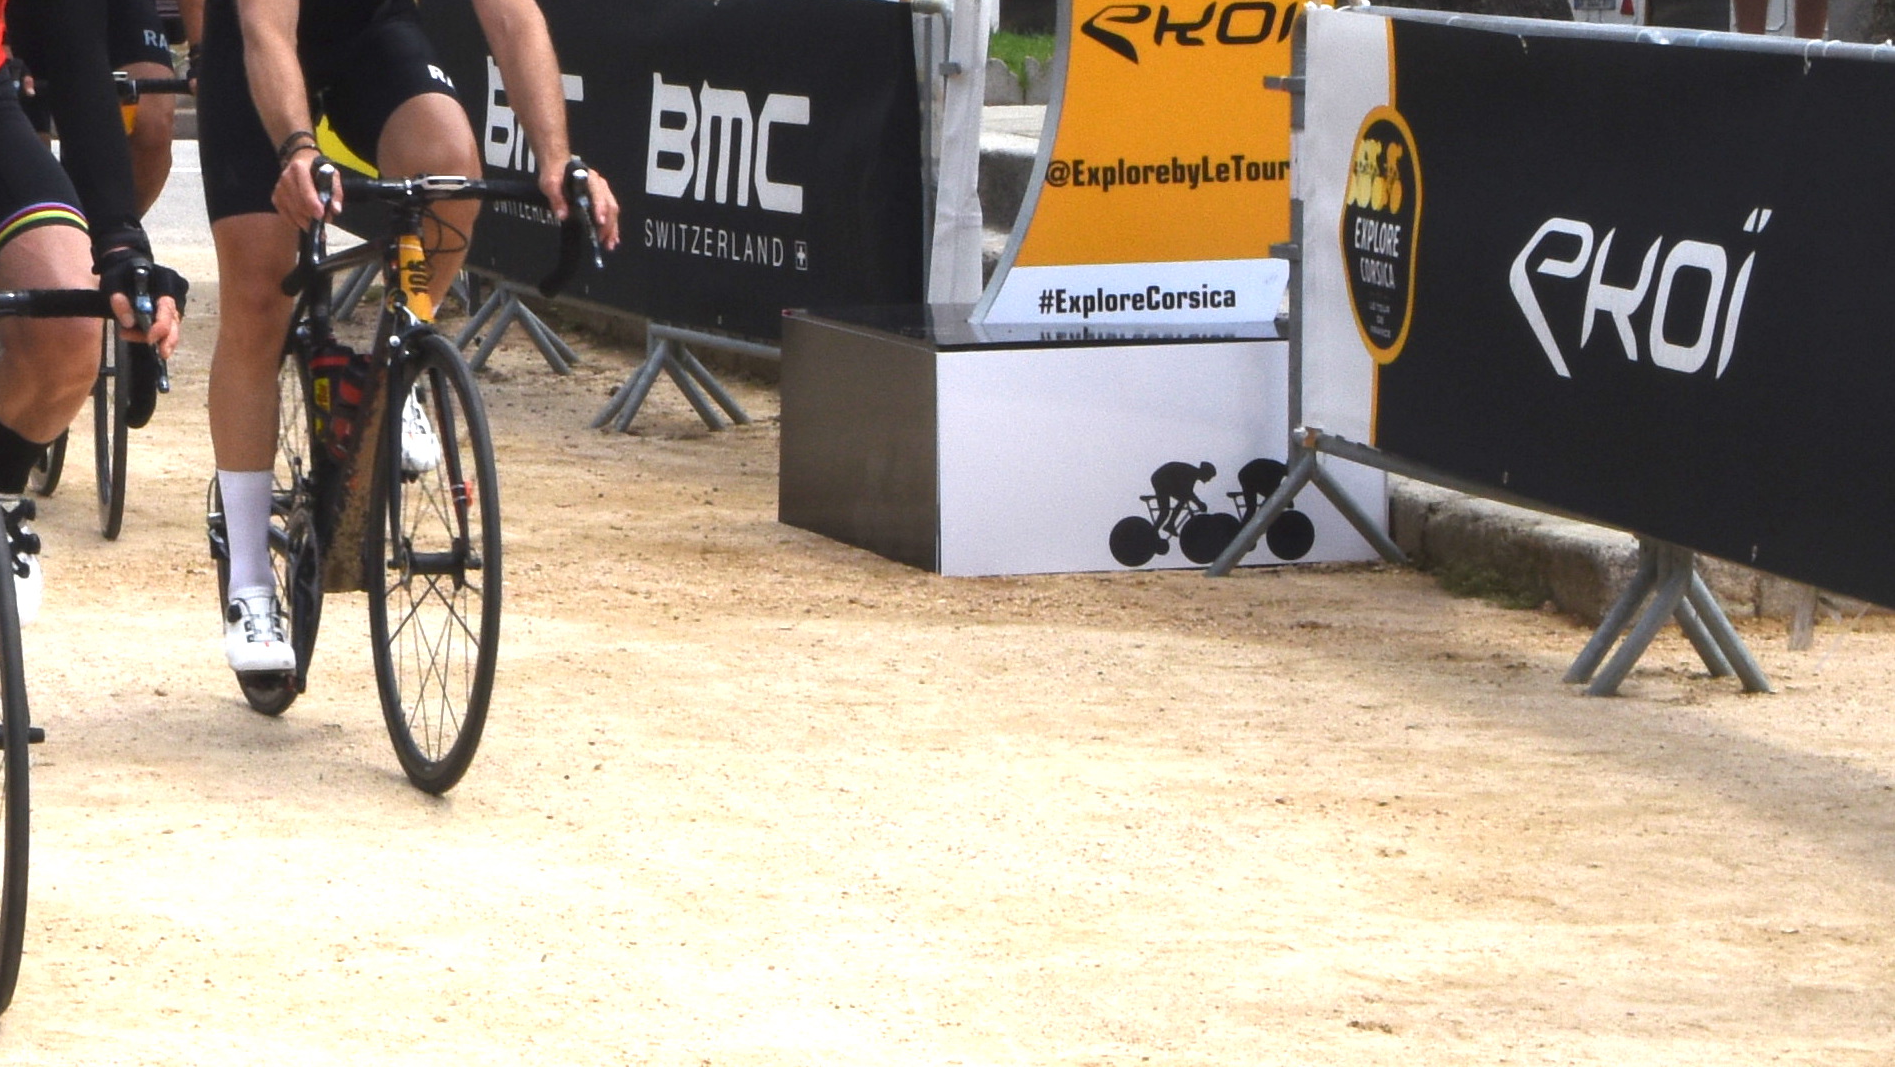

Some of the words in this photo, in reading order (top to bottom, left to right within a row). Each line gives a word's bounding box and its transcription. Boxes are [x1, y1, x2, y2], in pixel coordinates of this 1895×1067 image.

[645, 71, 810, 214] BMC
[1046, 155, 1290, 190] @ExplorebyLeTour
[645, 218, 785, 268] SWITZERLAND
[1355, 216, 1401, 259] EXPLORE
[1360, 257, 1396, 290] CORSICA
[1039, 285, 1236, 316] #ExploreCorsica
